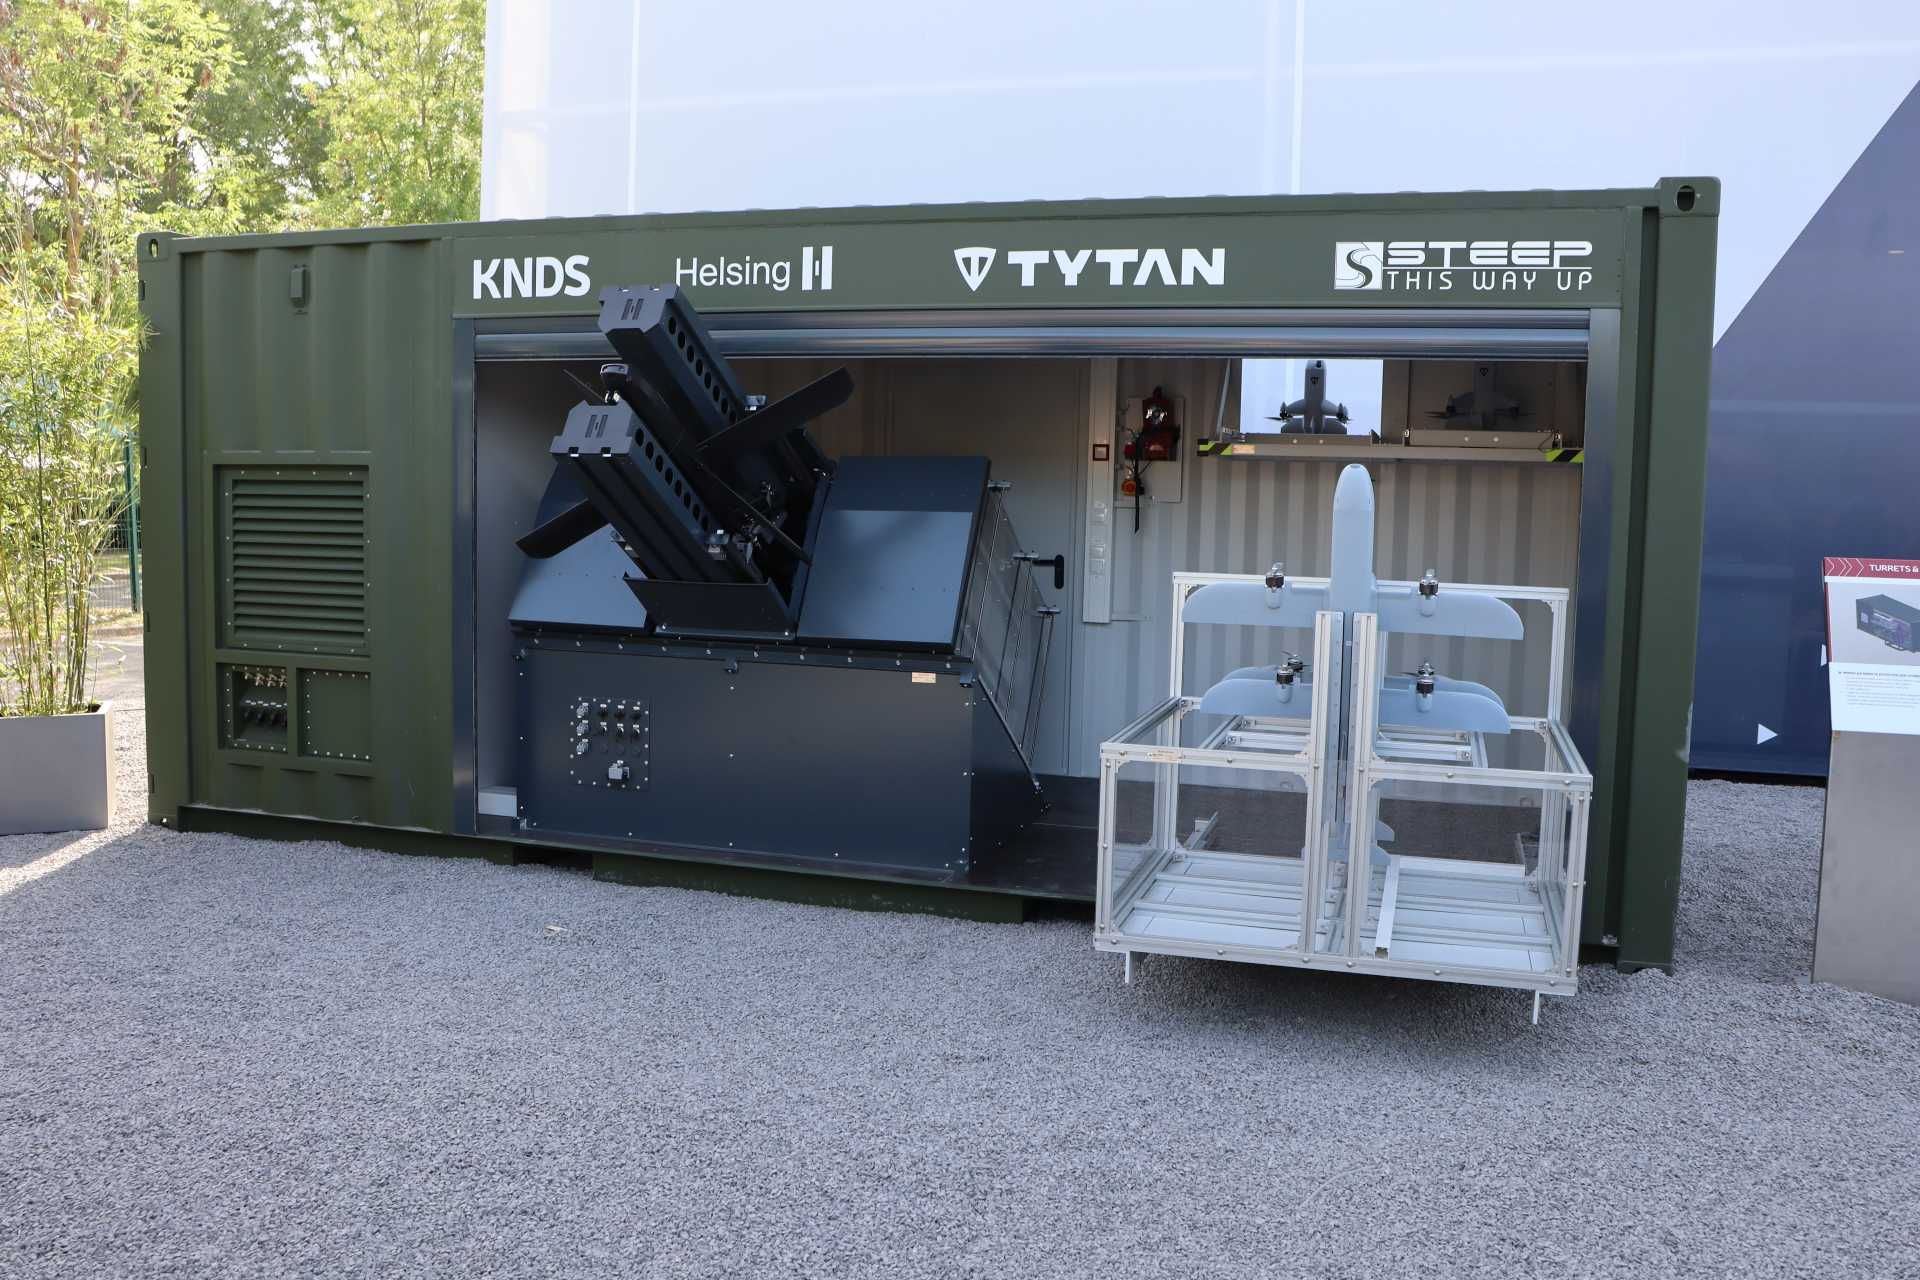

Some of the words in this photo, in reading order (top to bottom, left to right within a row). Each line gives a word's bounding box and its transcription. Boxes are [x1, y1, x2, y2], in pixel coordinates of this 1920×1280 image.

[1007, 248, 1226, 286] TYTAN
[1387, 241, 1592, 268] STEEP
[473, 255, 591, 299] KNDS
[676, 256, 791, 291] Helsing
[1387, 271, 1453, 290] THIS
[1472, 271, 1537, 290] WAY
[1557, 271, 1593, 291] UP
[1869, 564, 1911, 573] TURRETS
